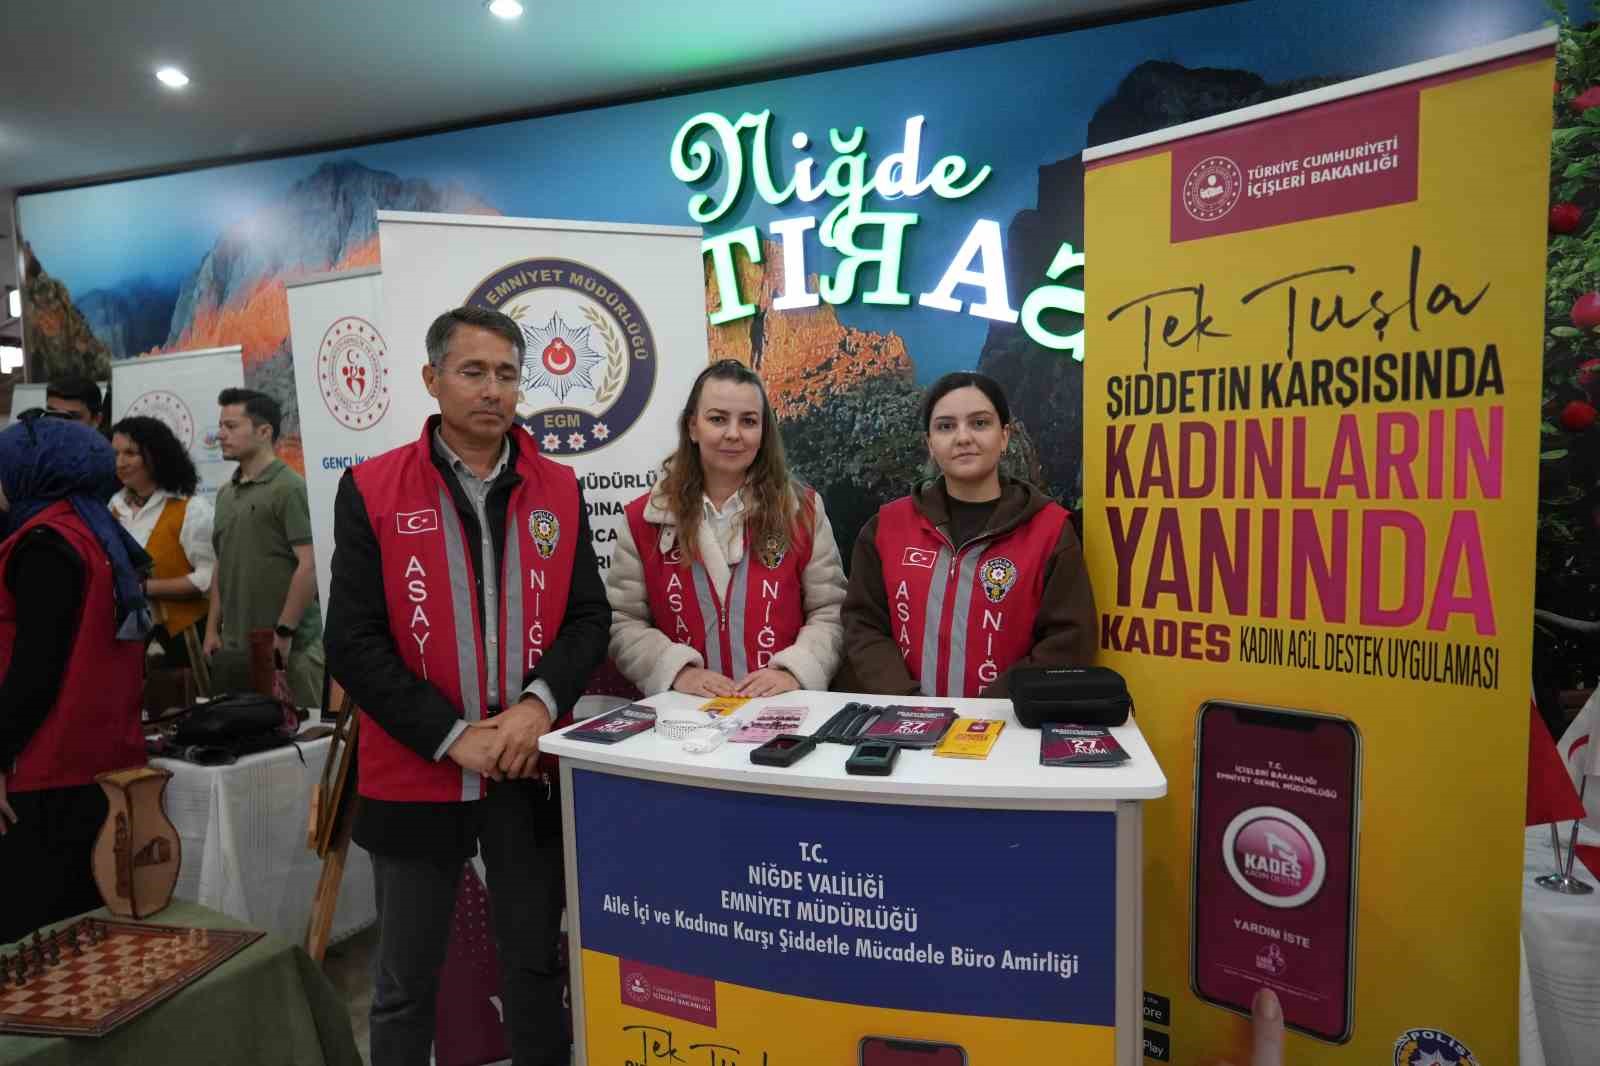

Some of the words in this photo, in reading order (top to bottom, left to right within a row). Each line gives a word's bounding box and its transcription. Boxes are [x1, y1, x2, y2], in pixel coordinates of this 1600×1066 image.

[670, 109, 992, 247] Niğde
[1247, 174, 1306, 200] İÇİŞLERİ
[1310, 154, 1399, 184] BAKANLIĞI
[1248, 158, 1300, 180] TÜRKİYE
[1302, 136, 1399, 168] CUMHURİYETİ
[486, 269, 563, 305] EMNİYET
[569, 271, 648, 361] MÜDÜRLÜĞÜ
[1107, 283, 1232, 371] Tek
[1241, 245, 1490, 360] Tuşla
[1260, 344, 1505, 408] KARŞISINDA
[543, 414, 581, 428] EGM
[1105, 406, 1504, 500] KADINLARIN
[1106, 506, 1497, 636] YANINDA
[1101, 613, 1231, 663] KADES
[1239, 625, 1284, 667] KADIN
[1287, 631, 1320, 671] ACİL
[1324, 632, 1386, 677] DESTEK
[1387, 637, 1500, 690] UYGULAMASI
[798, 842, 828, 864] T.C.
[1245, 853, 1302, 880] KADES
[749, 862, 802, 891] NİĞDE
[807, 871, 884, 900] VALİLİĞİ
[721, 890, 792, 919] EMNİYET
[797, 899, 918, 933] MÜDÜRLÜĞÜ
[1234, 919, 1281, 940] YARDIM
[1283, 926, 1311, 949] İSTE
[603, 894, 630, 916] Aile
[633, 896, 650, 925] İçi
[653, 911, 671, 925] ve
[675, 909, 728, 937] Kadına
[733, 921, 774, 950] Karşı
[778, 928, 849, 957] Şiddetle
[855, 937, 945, 966] Mücadele
[951, 946, 995, 969] Büro
[1001, 950, 1079, 979] Amirliği
[622, 1025, 687, 1065] Tek
